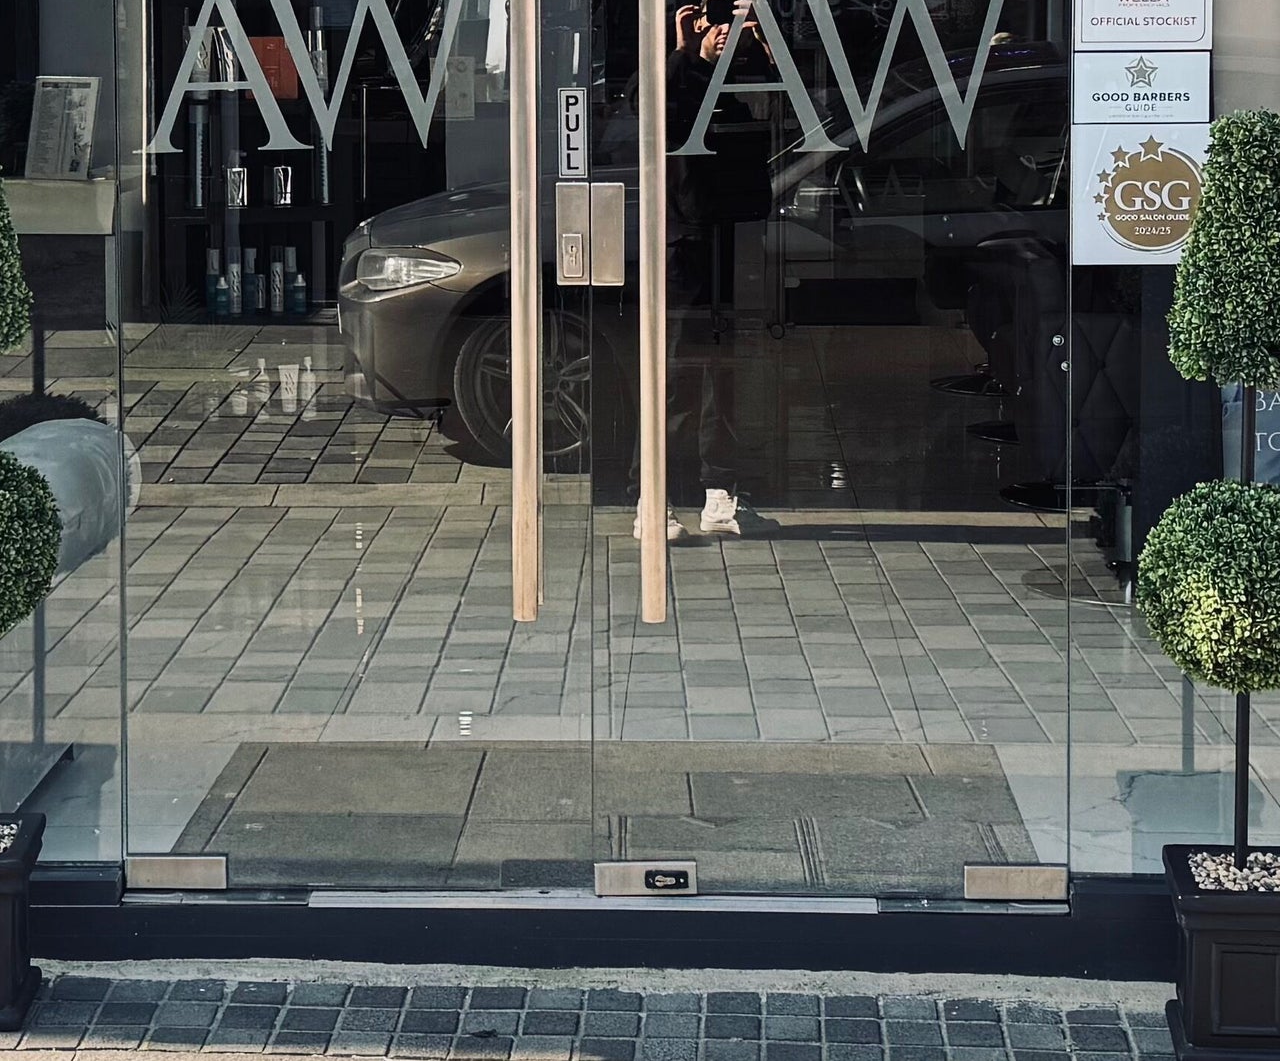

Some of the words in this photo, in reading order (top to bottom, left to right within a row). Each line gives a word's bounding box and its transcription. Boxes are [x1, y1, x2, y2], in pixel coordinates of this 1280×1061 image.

[1090, 16, 1140, 26] OFFICIAL
[1143, 16, 1197, 26] STOCKIST
[1091, 92, 1130, 102] GOOD
[1133, 92, 1191, 102] BARBERS
[1124, 103, 1158, 112] GUIDE
[565, 95, 580, 170] PULL
[1114, 180, 1192, 212] GSG
[1114, 213, 1138, 221] GOOD
[1139, 213, 1166, 221] SALON
[1166, 213, 1190, 221] GUIDE
[1134, 226, 1171, 236] 2024/25
